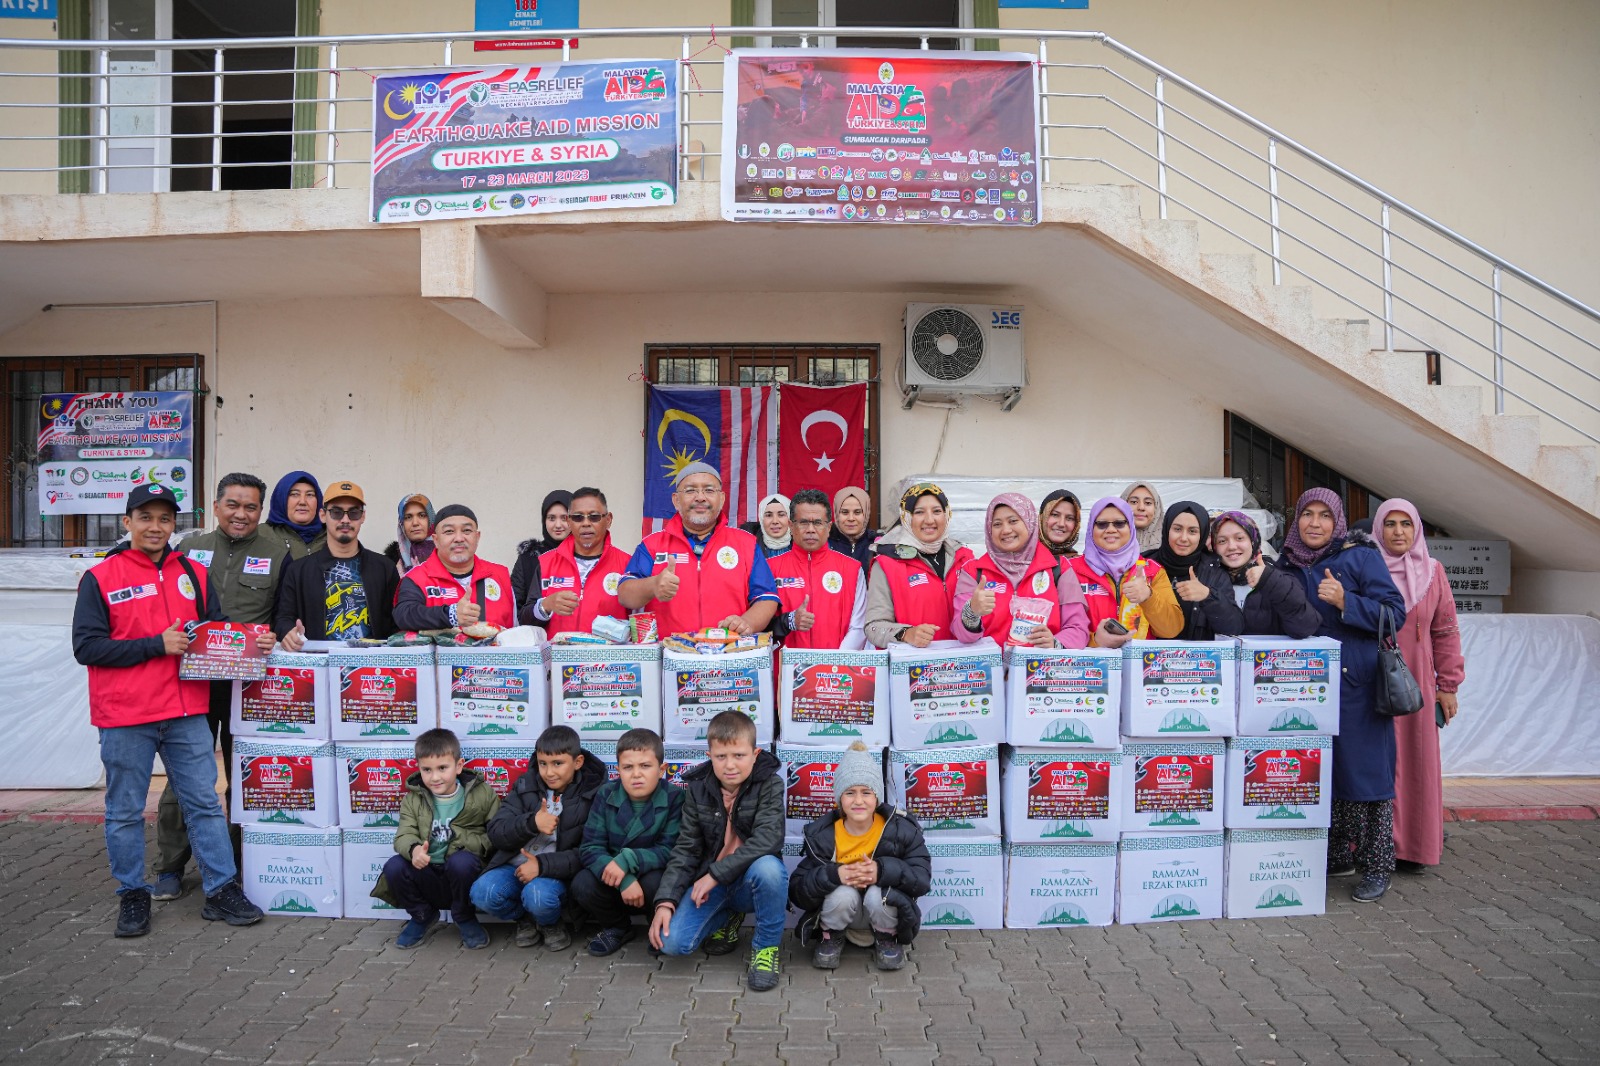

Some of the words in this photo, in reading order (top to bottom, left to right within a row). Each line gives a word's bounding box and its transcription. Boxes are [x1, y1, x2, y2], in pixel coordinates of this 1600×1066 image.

[604, 69, 648, 78] MALAYSIA
[848, 84, 905, 94] MALAYSIA
[394, 121, 532, 144] EARTHQUAKE
[536, 118, 570, 135] AID
[576, 113, 660, 133] MISSION
[442, 149, 525, 167] TURKIYE
[530, 147, 544, 162] &
[550, 143, 609, 160] SYRIA
[461, 176, 476, 188] 17
[487, 174, 504, 186] 23
[506, 172, 553, 186] MARCH
[556, 170, 589, 183] 2023
[992, 312, 1020, 325] SEG
[76, 398, 124, 410] THANK
[128, 397, 158, 408] YOU
[48, 434, 120, 446] EARTHQUAKE
[122, 434, 138, 442] AID
[141, 432, 182, 442] MISSION
[268, 864, 314, 874] RAMAZAN
[1259, 860, 1303, 870] RAMAZAN
[362, 873, 378, 881] ERZ
[1152, 868, 1199, 878] RAMAZAN
[1250, 872, 1278, 881] ERZAK
[1281, 869, 1311, 880] PAKETİ
[259, 875, 288, 884] ERZAK
[290, 875, 322, 885] PAKETİ
[932, 878, 975, 886] AMAZAN
[1041, 878, 1089, 886] RAMAZAN
[1143, 880, 1174, 889] ERZAK
[1176, 877, 1208, 888] PAKETİ
[950, 887, 984, 897] PAKETİ
[1065, 887, 1098, 896] PAKETİ
